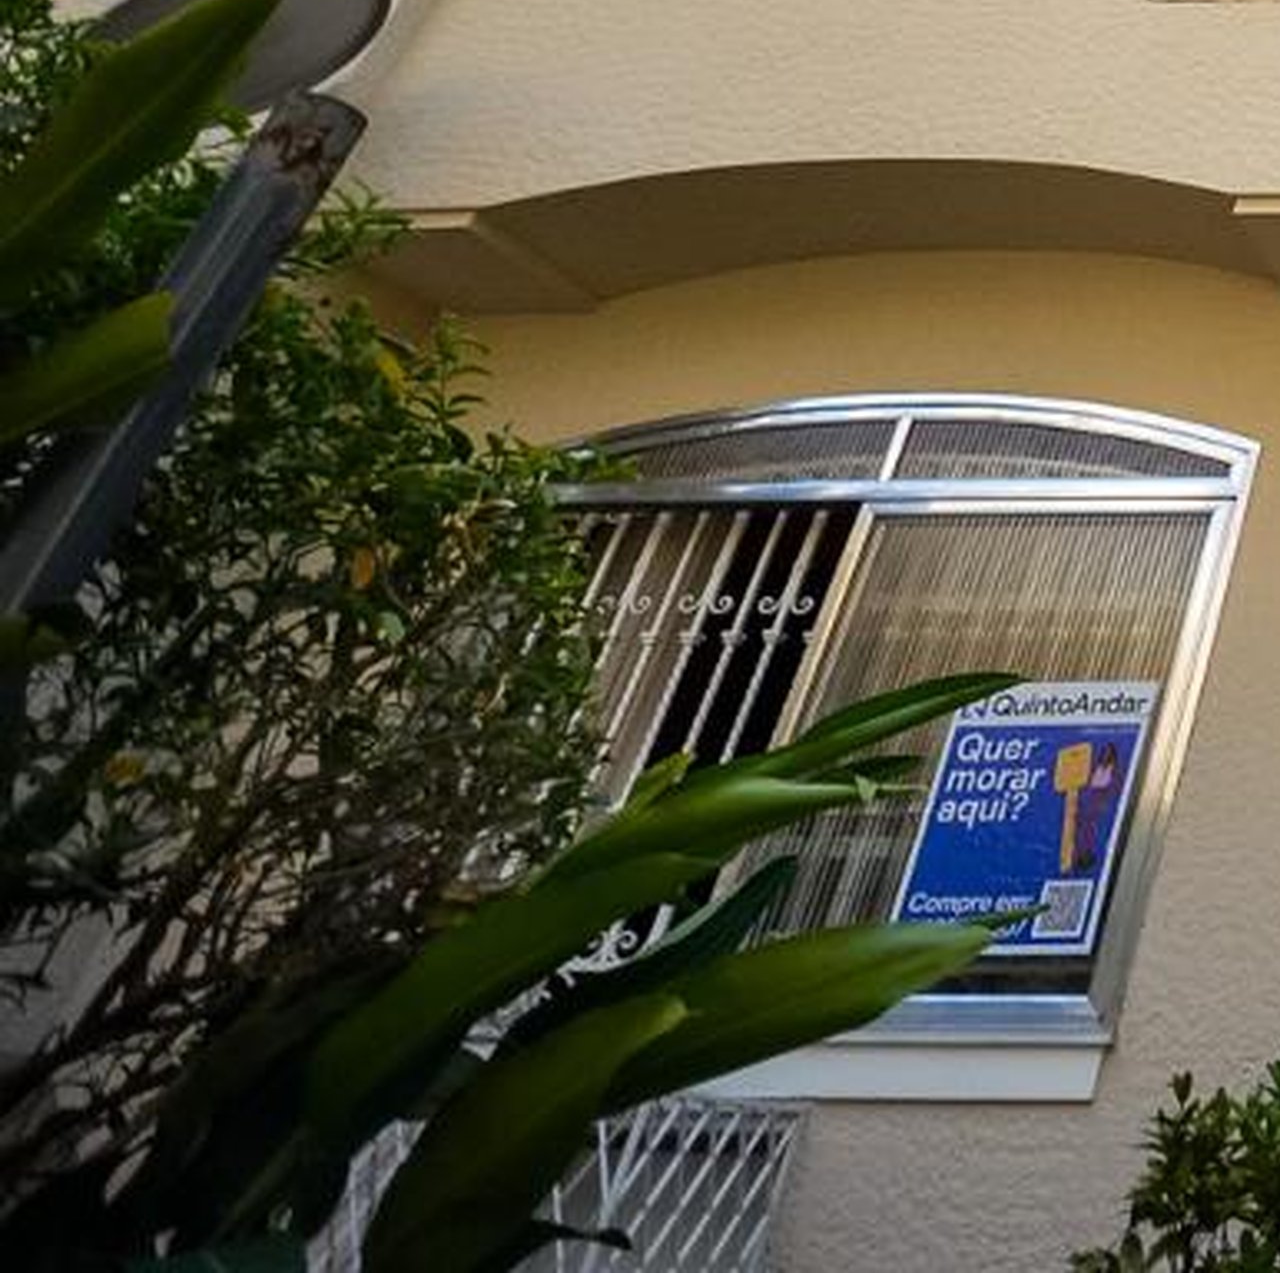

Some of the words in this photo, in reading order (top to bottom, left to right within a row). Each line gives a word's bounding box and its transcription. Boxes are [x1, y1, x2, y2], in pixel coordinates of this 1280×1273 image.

[992, 693, 1149, 717] QuintoAndar
[957, 733, 1039, 762] Quer
[945, 768, 1046, 792] morar
[937, 792, 1029, 830] aqui?
[908, 892, 993, 916] Compre
